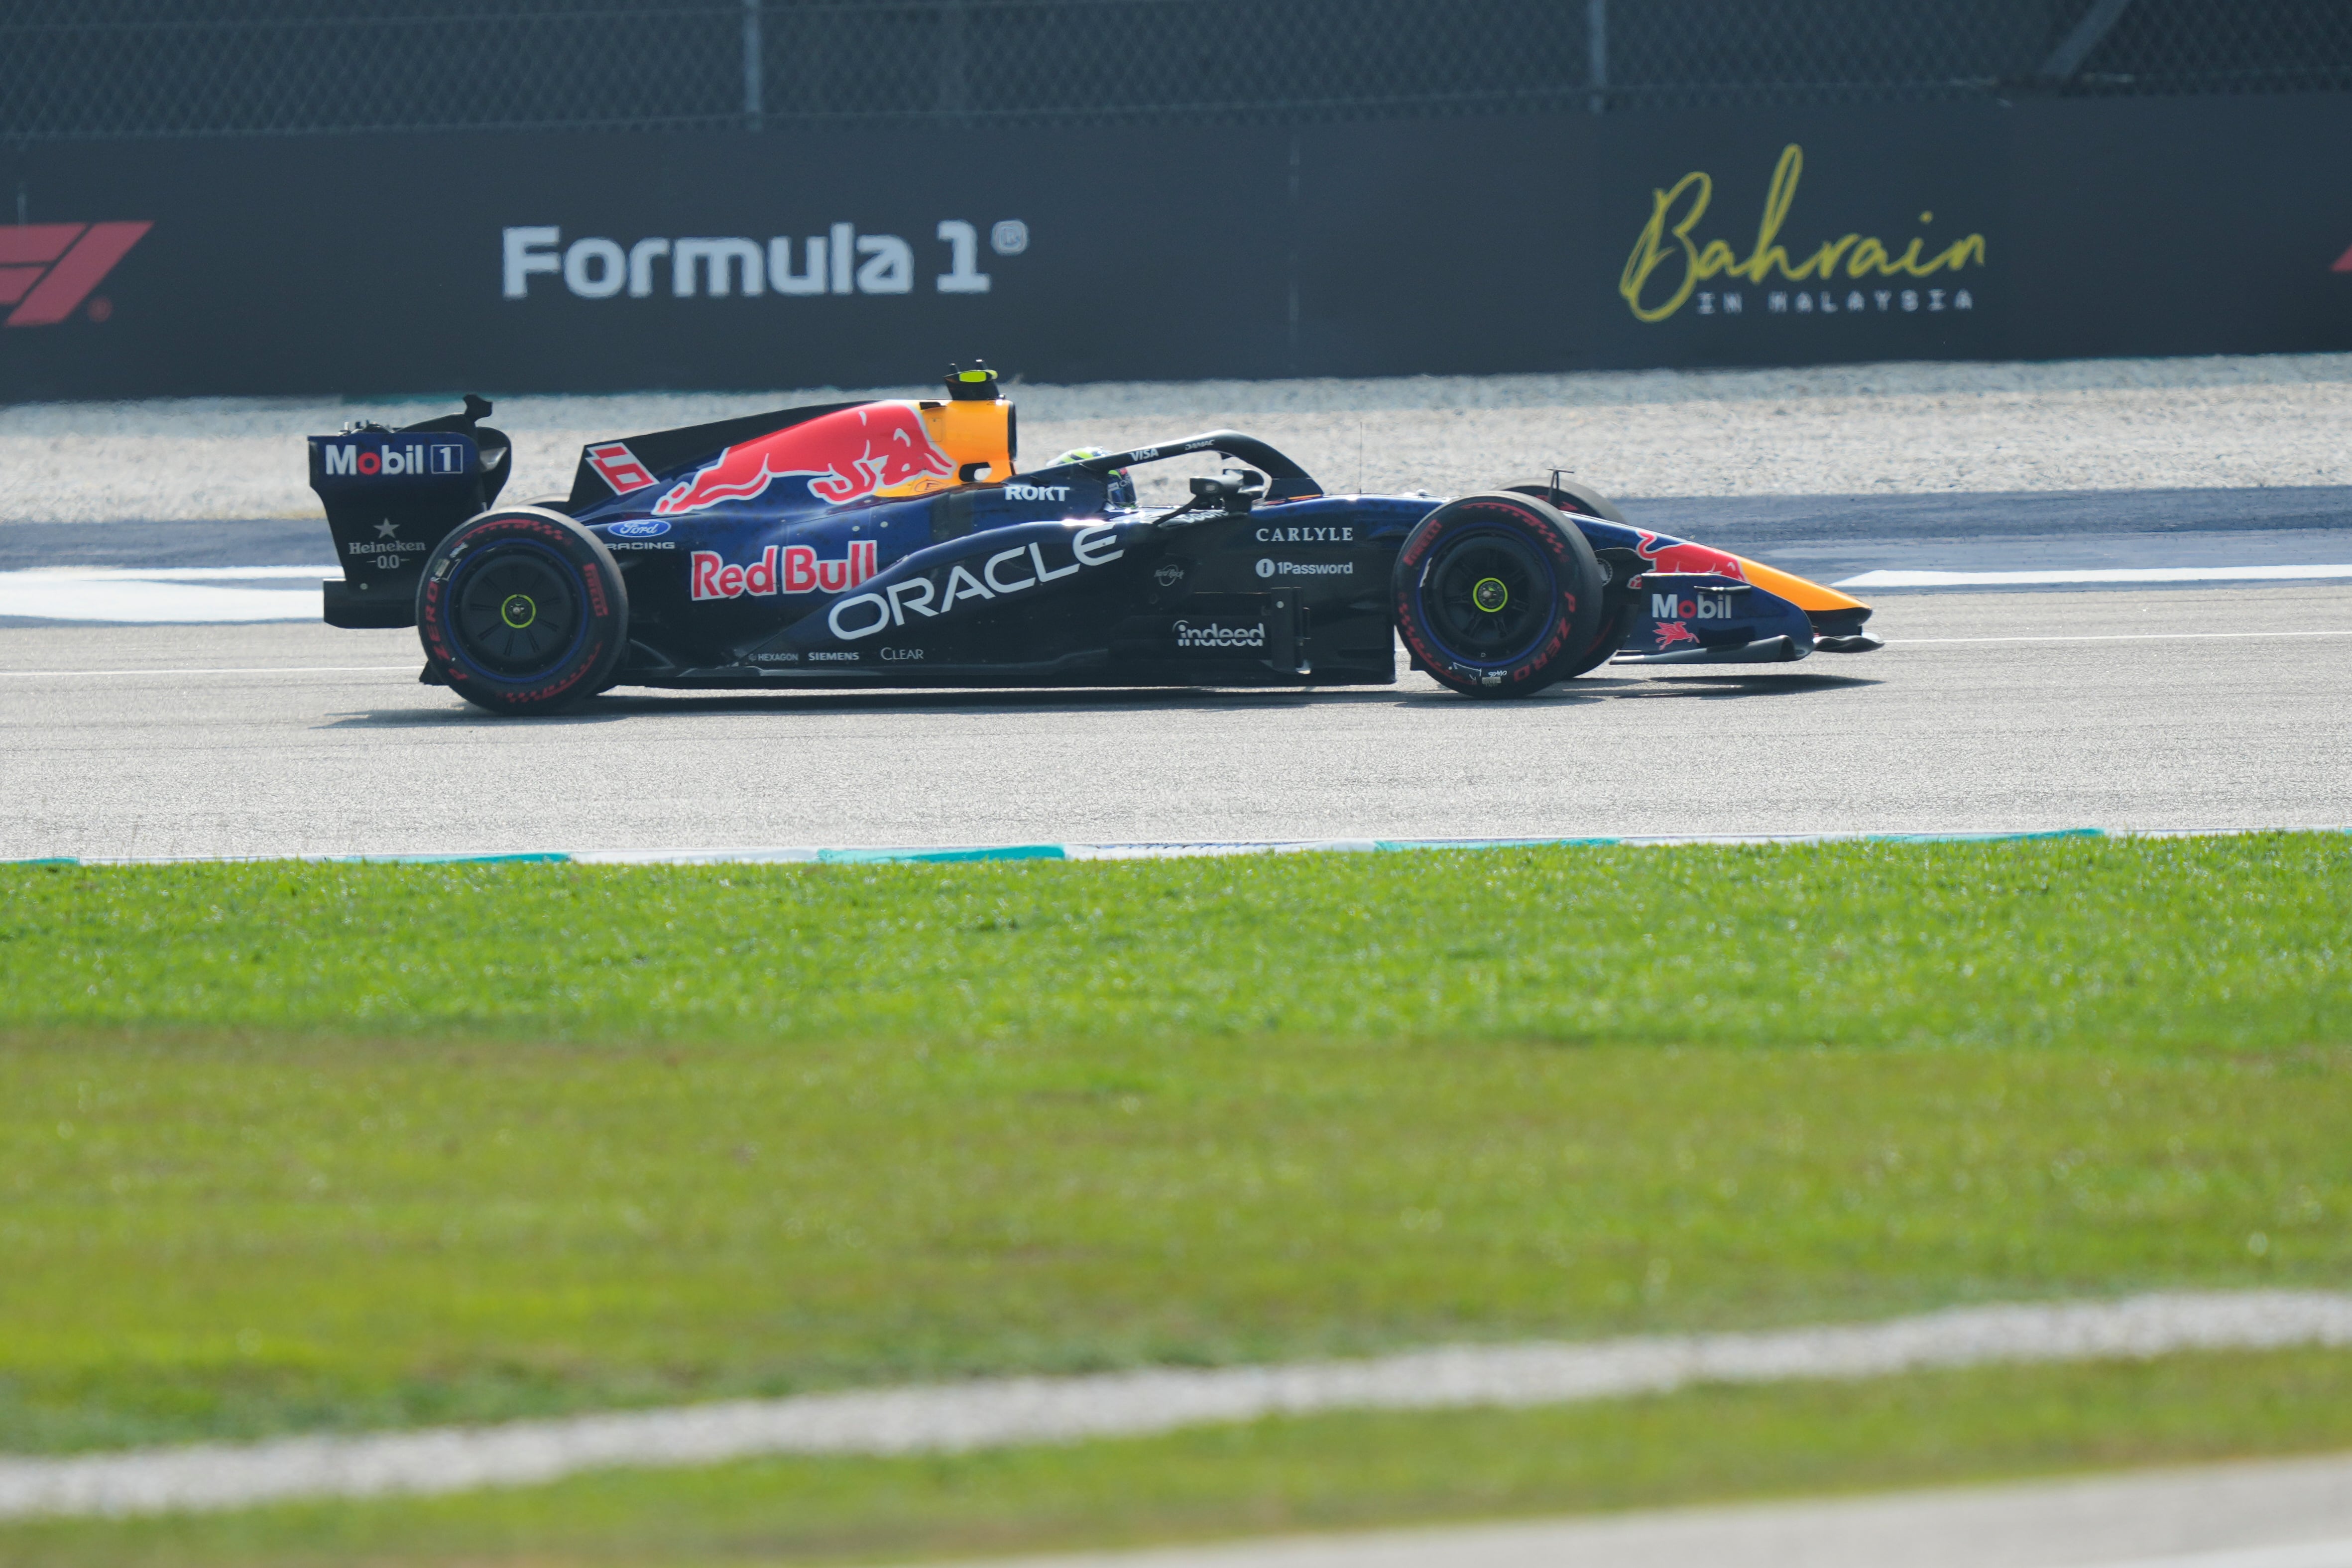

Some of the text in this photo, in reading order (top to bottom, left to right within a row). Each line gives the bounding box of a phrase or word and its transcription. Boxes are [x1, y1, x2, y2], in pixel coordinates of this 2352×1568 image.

[1619, 143, 1985, 322] Bahrain
[502, 222, 914, 297] Formula
[1697, 289, 1973, 314] IN MALAYSIA
[326, 445, 452, 475] Mobil 1
[1129, 448, 1159, 462] VISA
[1004, 486, 1070, 501] ROKT
[619, 521, 658, 534] Ford
[1256, 527, 1353, 542] CARLYLE
[349, 541, 426, 554] Heineken
[377, 555, 400, 569] 0.0
[1278, 562, 1353, 574] 1Password
[692, 541, 876, 600] Red Bull
[828, 523, 1124, 640] ORACLE
[1652, 594, 1731, 619] Mobil
[1173, 621, 1265, 646] indeed
[758, 653, 798, 662] HEXAGON
[809, 652, 859, 661] SIEMENS
[880, 647, 924, 660] CLEAR
